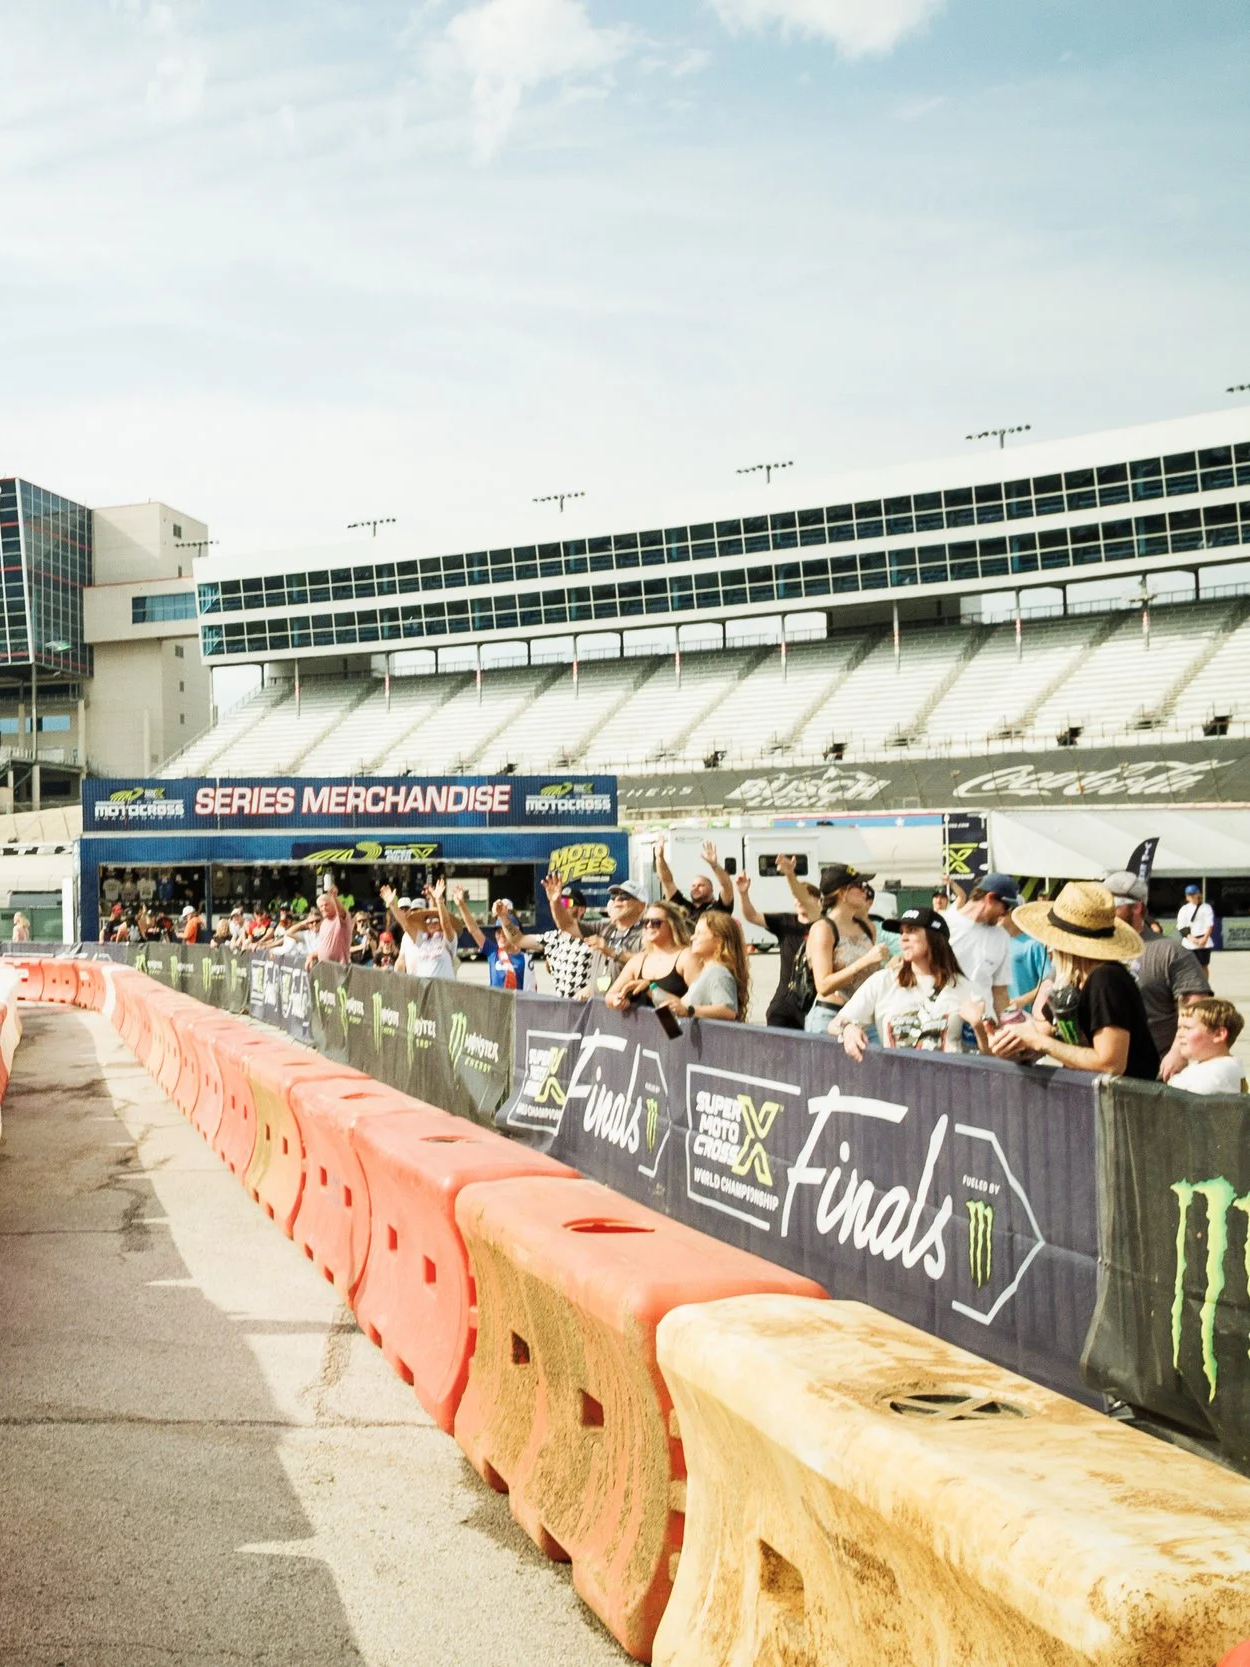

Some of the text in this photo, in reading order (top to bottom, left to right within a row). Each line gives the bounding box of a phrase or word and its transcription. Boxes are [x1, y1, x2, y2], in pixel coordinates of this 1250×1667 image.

[94, 804, 184, 816] MOTOCROSS
[195, 784, 511, 815] SERIES MERCHANDISE
[526, 799, 611, 811] MOTOCROSS
[549, 843, 610, 873] MOTO
[560, 858, 617, 884] TEES
[554, 1028, 642, 1154] Finals
[696, 1091, 743, 1121] SUPER
[699, 1114, 740, 1143] MOTO
[693, 1134, 741, 1167] CROSS
[694, 1166, 779, 1212] WORLD CHAMPIONSHIP
[781, 1085, 953, 1280] Finals
[962, 1174, 1000, 1195] FUELED BY
